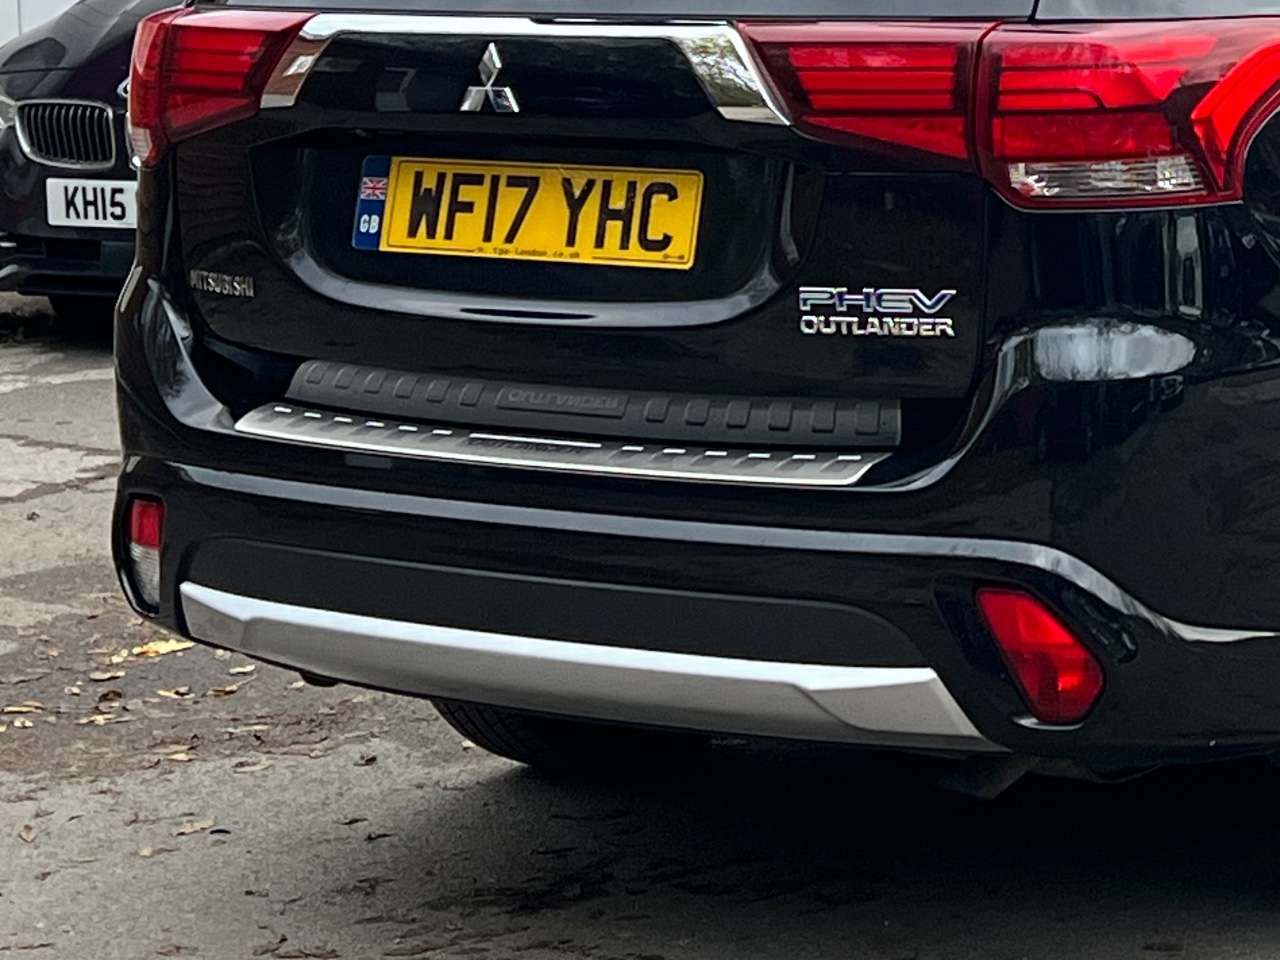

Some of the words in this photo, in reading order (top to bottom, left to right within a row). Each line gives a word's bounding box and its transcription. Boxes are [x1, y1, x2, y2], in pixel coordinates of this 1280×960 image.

[64, 185, 126, 221] KH15
[407, 170, 540, 244] WF17
[562, 176, 679, 252] YHC
[359, 214, 380, 234] GB
[799, 287, 957, 314] PHEV
[801, 315, 955, 336] OUTLANDER
